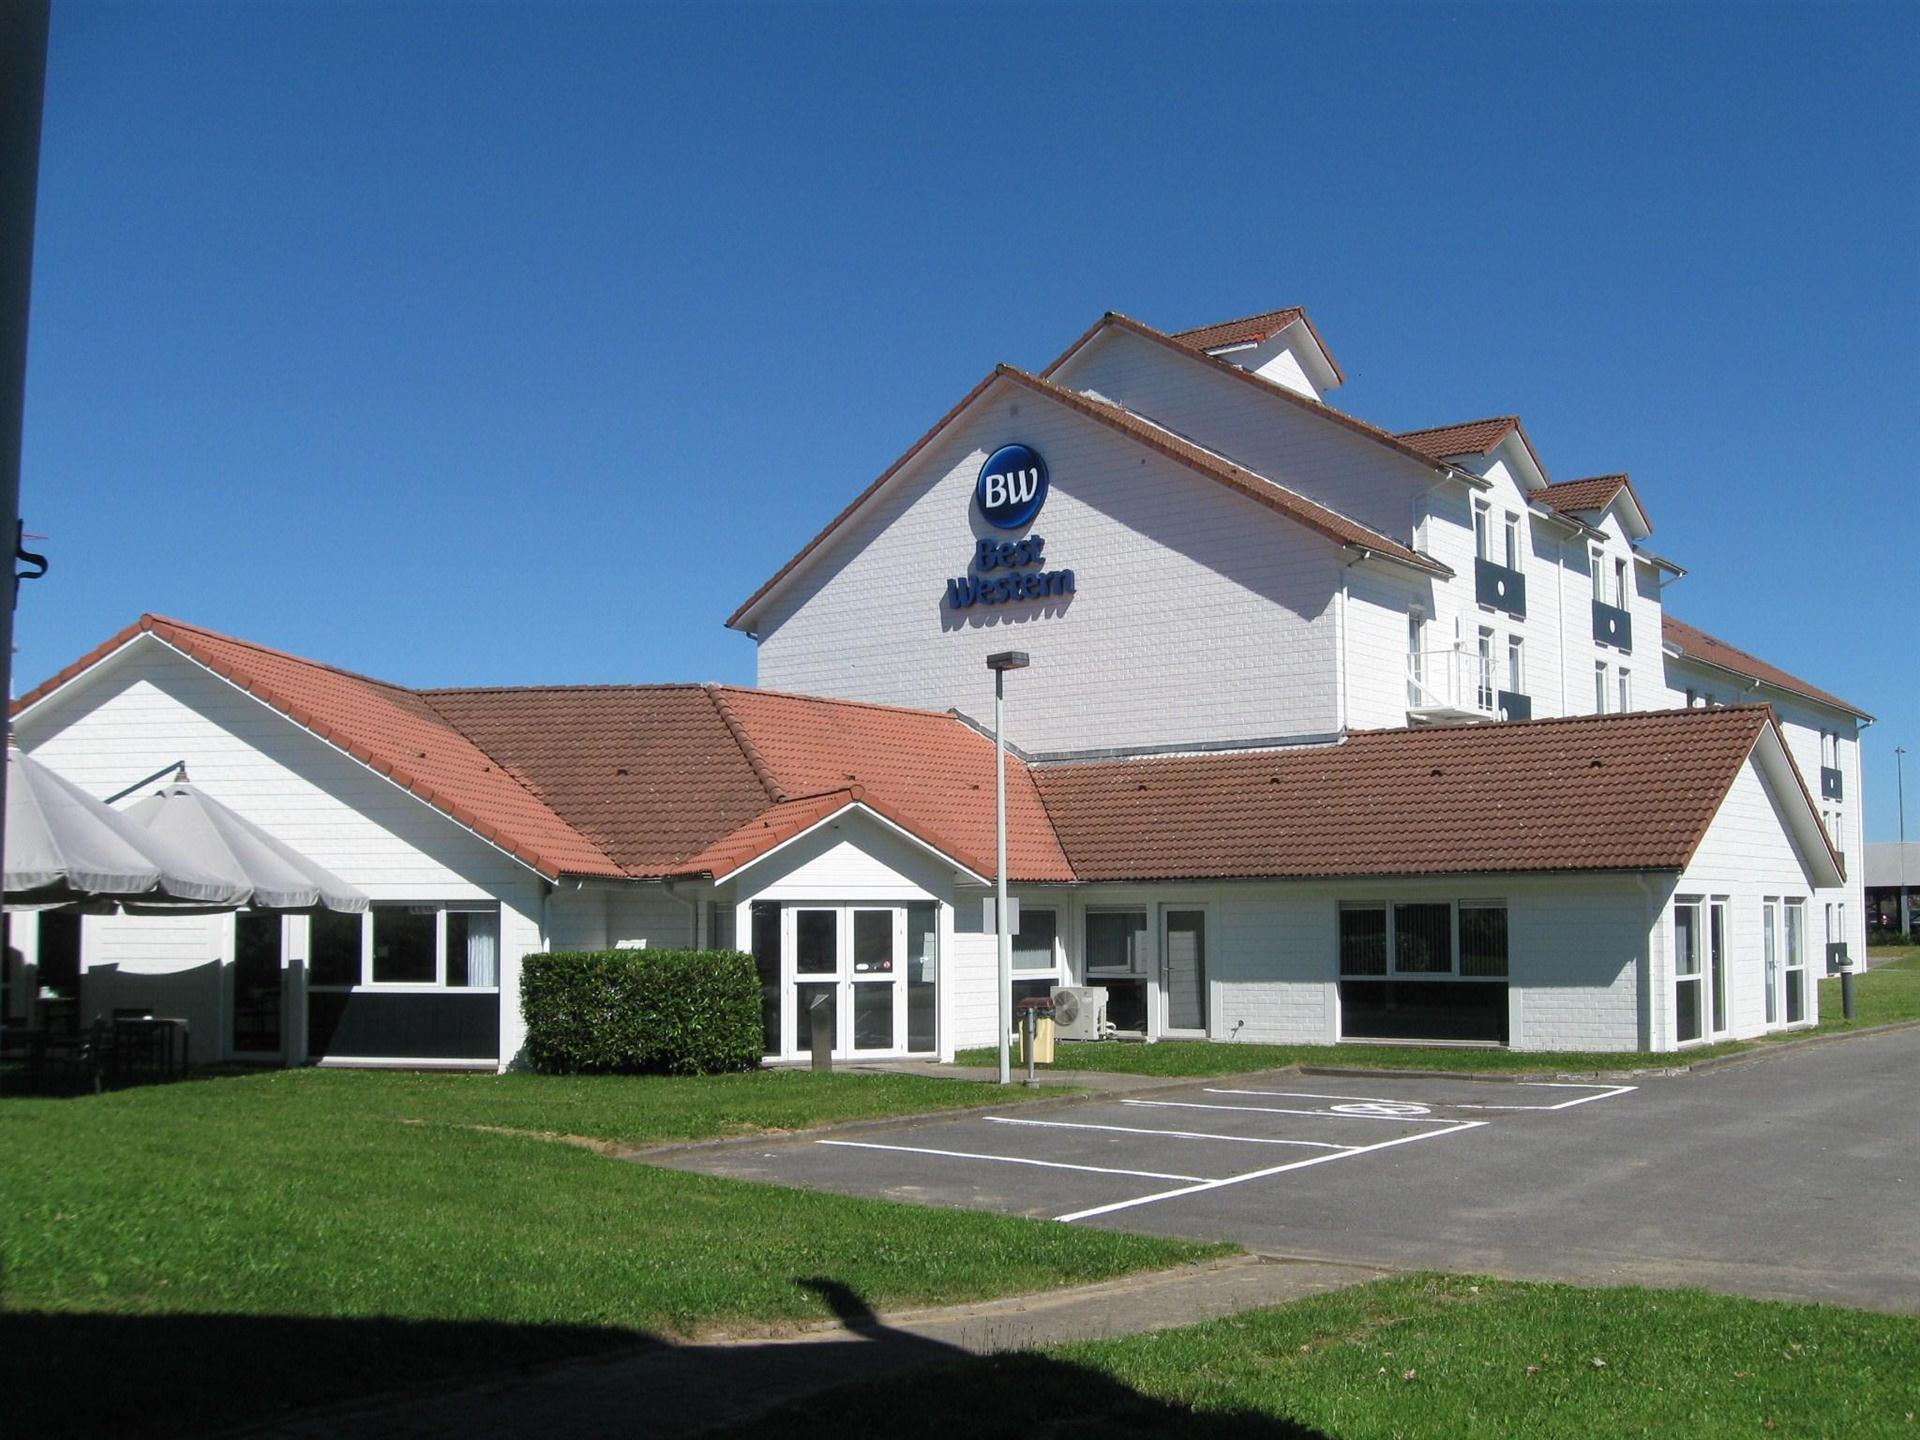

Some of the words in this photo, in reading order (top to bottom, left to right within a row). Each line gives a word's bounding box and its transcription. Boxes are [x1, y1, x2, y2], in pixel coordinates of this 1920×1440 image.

[985, 467, 1038, 508] BW
[975, 534, 1046, 572] Best
[947, 568, 1077, 609] Western
